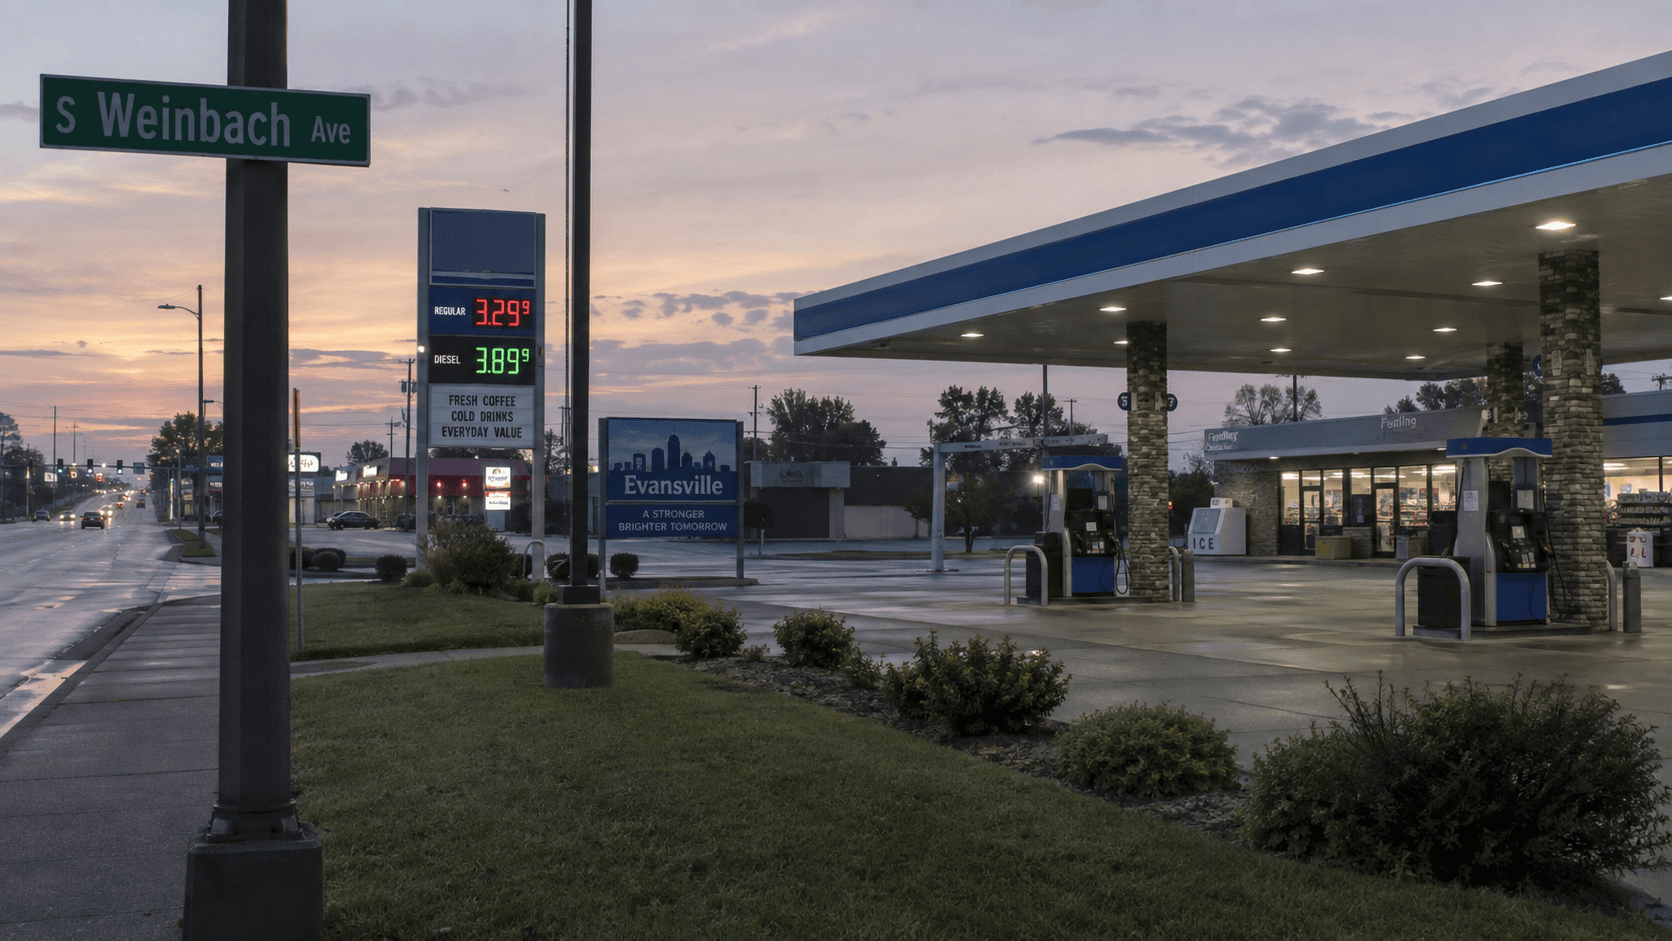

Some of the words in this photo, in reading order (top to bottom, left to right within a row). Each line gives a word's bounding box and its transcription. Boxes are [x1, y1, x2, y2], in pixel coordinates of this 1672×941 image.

[55, 96, 76, 134] S
[97, 91, 291, 147] Weinbach
[310, 115, 351, 144] Ave
[434, 306, 466, 316] REGULAR
[434, 355, 461, 364] DIESEL
[449, 395, 478, 406] FRESH
[482, 395, 516, 407] COFFEE
[451, 411, 475, 422] COLD
[480, 411, 514, 422] DRINKS
[442, 426, 489, 438] EVERYDAY
[494, 427, 522, 438] VALUE
[624, 474, 723, 495] Evansville
[642, 509, 650, 519] A
[652, 509, 705, 519] STRONGER
[618, 522, 667, 531] BRIGHTER
[671, 522, 728, 531] TOMORROW
[1192, 537, 1215, 550] ICE
